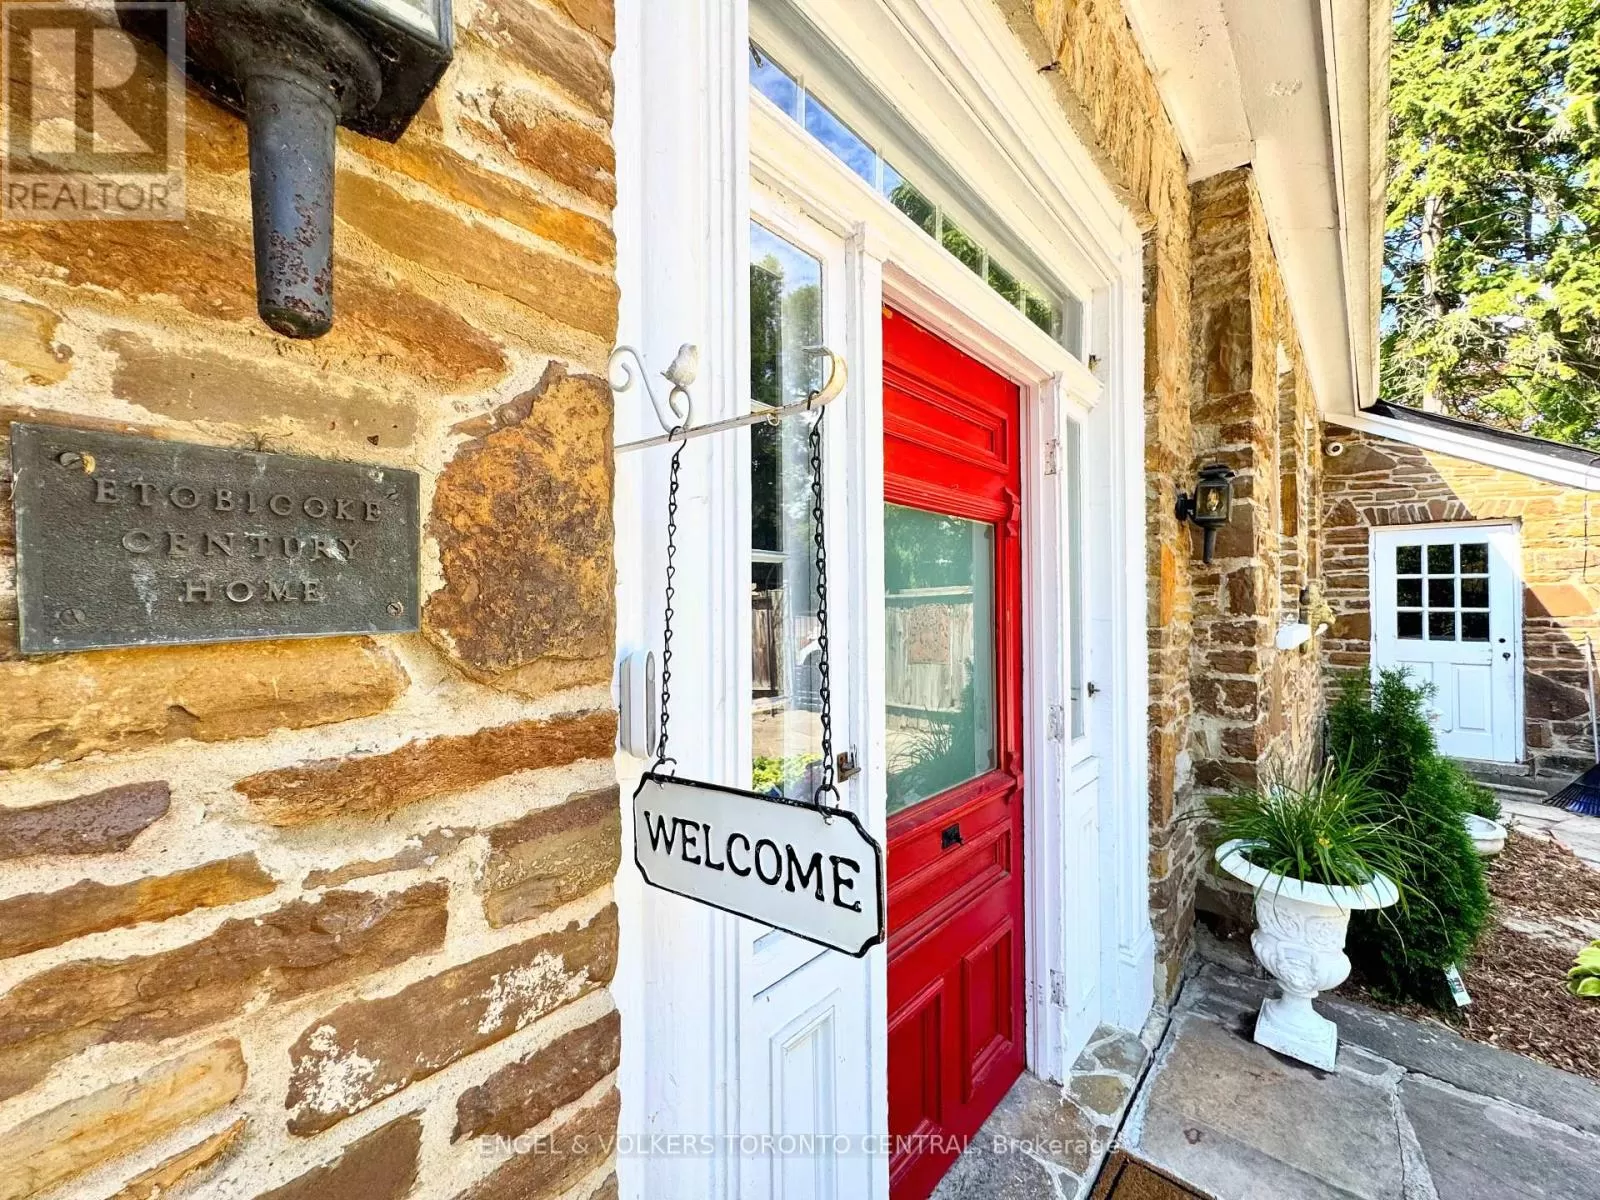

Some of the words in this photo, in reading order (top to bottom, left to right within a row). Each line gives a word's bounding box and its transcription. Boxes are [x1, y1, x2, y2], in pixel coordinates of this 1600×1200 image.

[94, 476, 384, 523] ETOBICOKE
[122, 529, 363, 562] CENTURY
[183, 579, 324, 604] HOME
[643, 810, 862, 913] WELCOME
